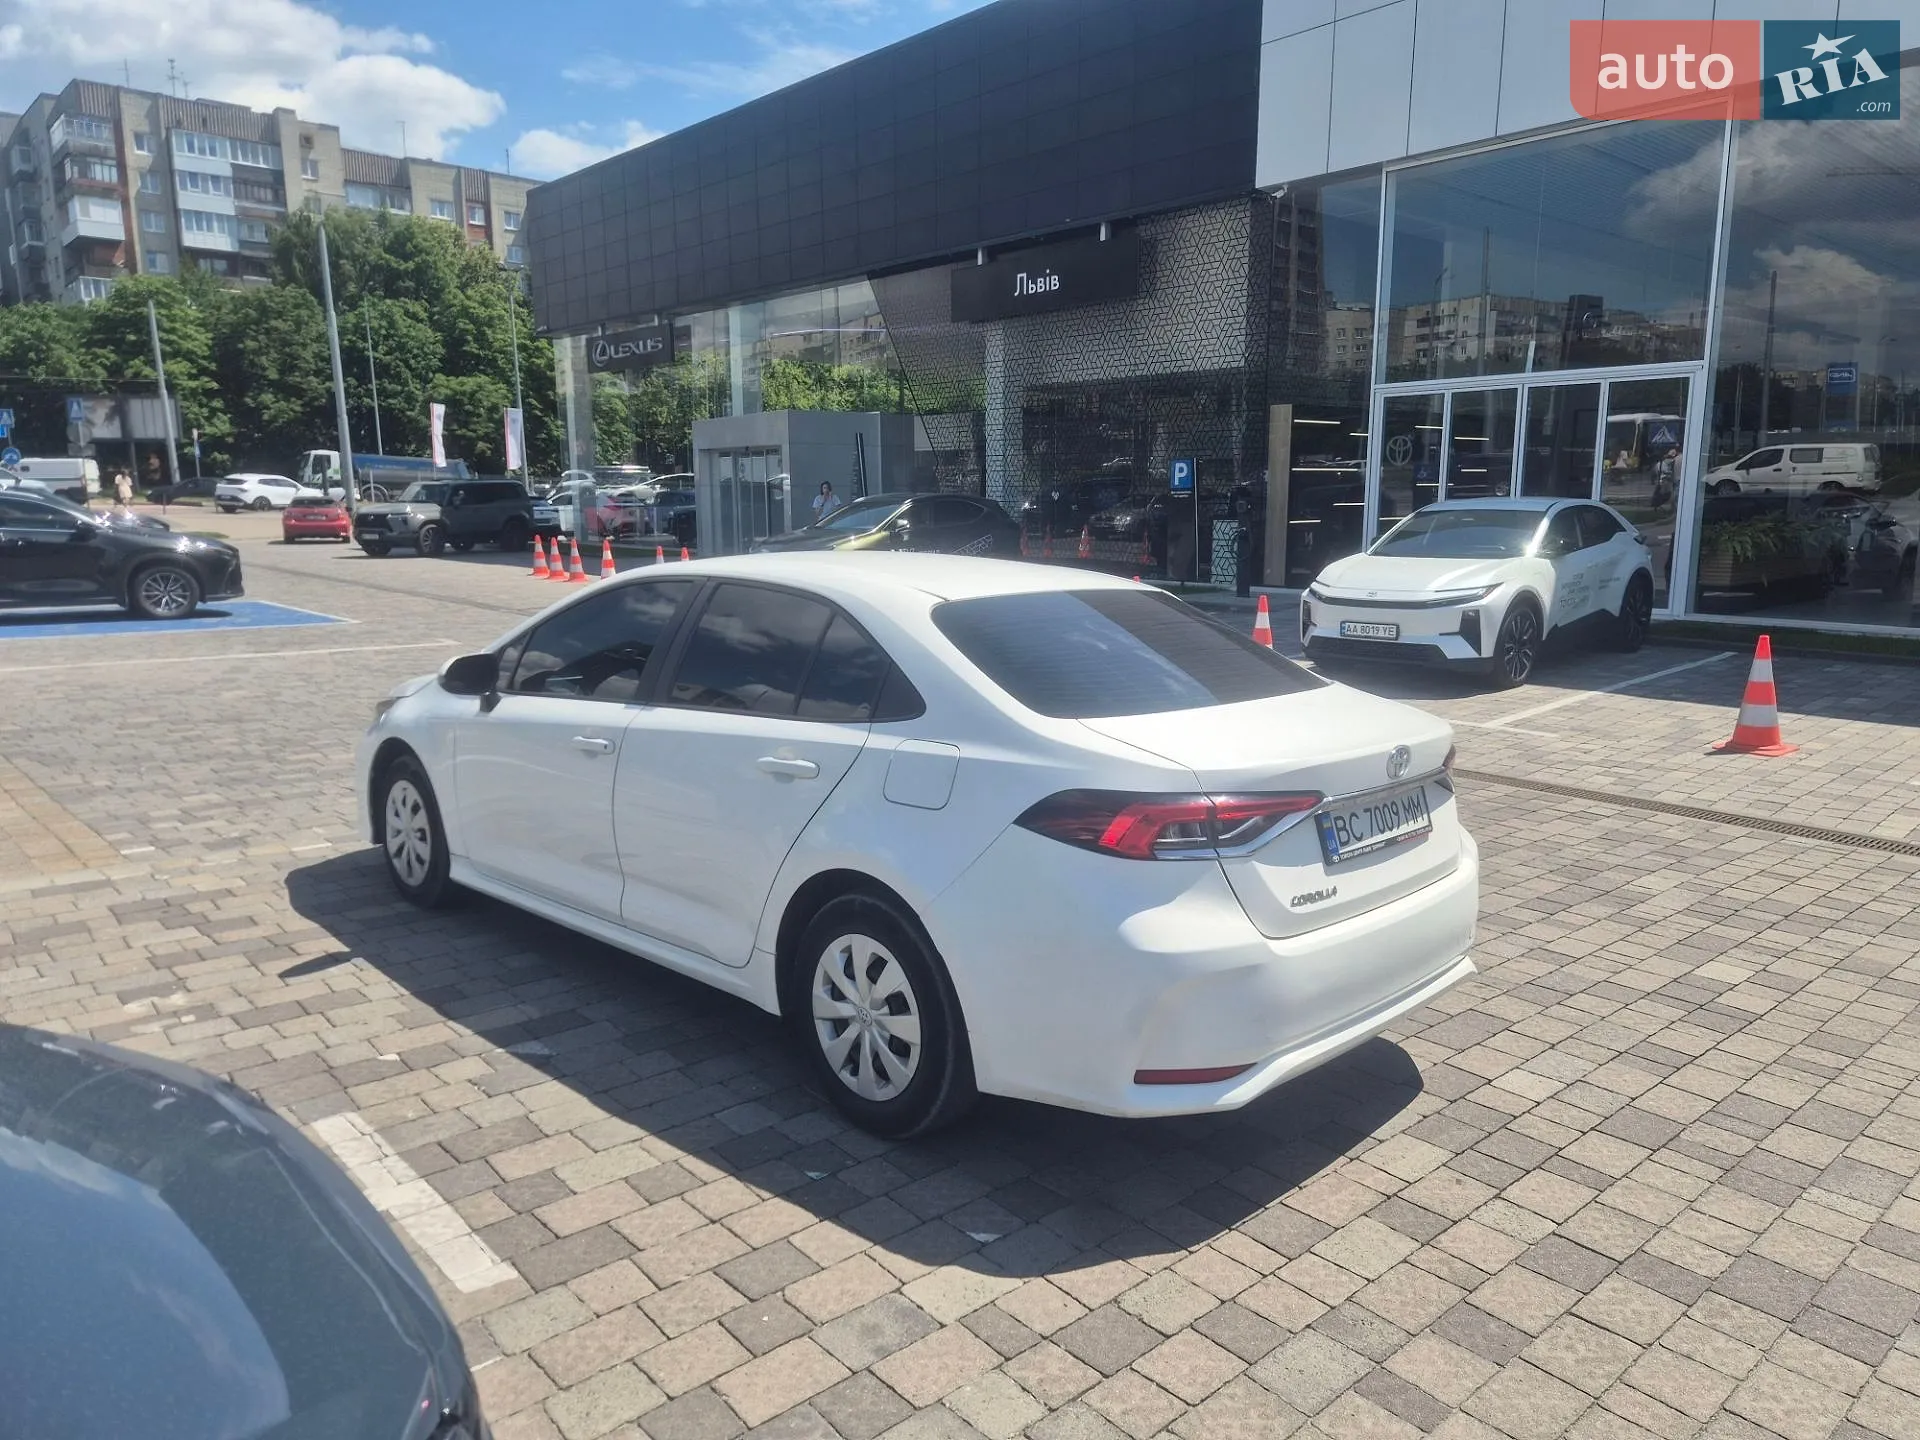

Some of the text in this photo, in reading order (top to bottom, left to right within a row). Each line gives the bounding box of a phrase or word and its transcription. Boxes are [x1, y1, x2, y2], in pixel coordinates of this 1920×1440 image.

[1014, 268, 1060, 297] Львів
[610, 337, 663, 358] LEXUS
[1174, 462, 1188, 486] P
[1346, 624, 1358, 634] AA
[1360, 625, 1380, 635] 8019
[1334, 812, 1364, 846] BC
[1363, 801, 1400, 838] 7009
[1401, 793, 1425, 826] MM
[1290, 886, 1337, 907] COROLLA
